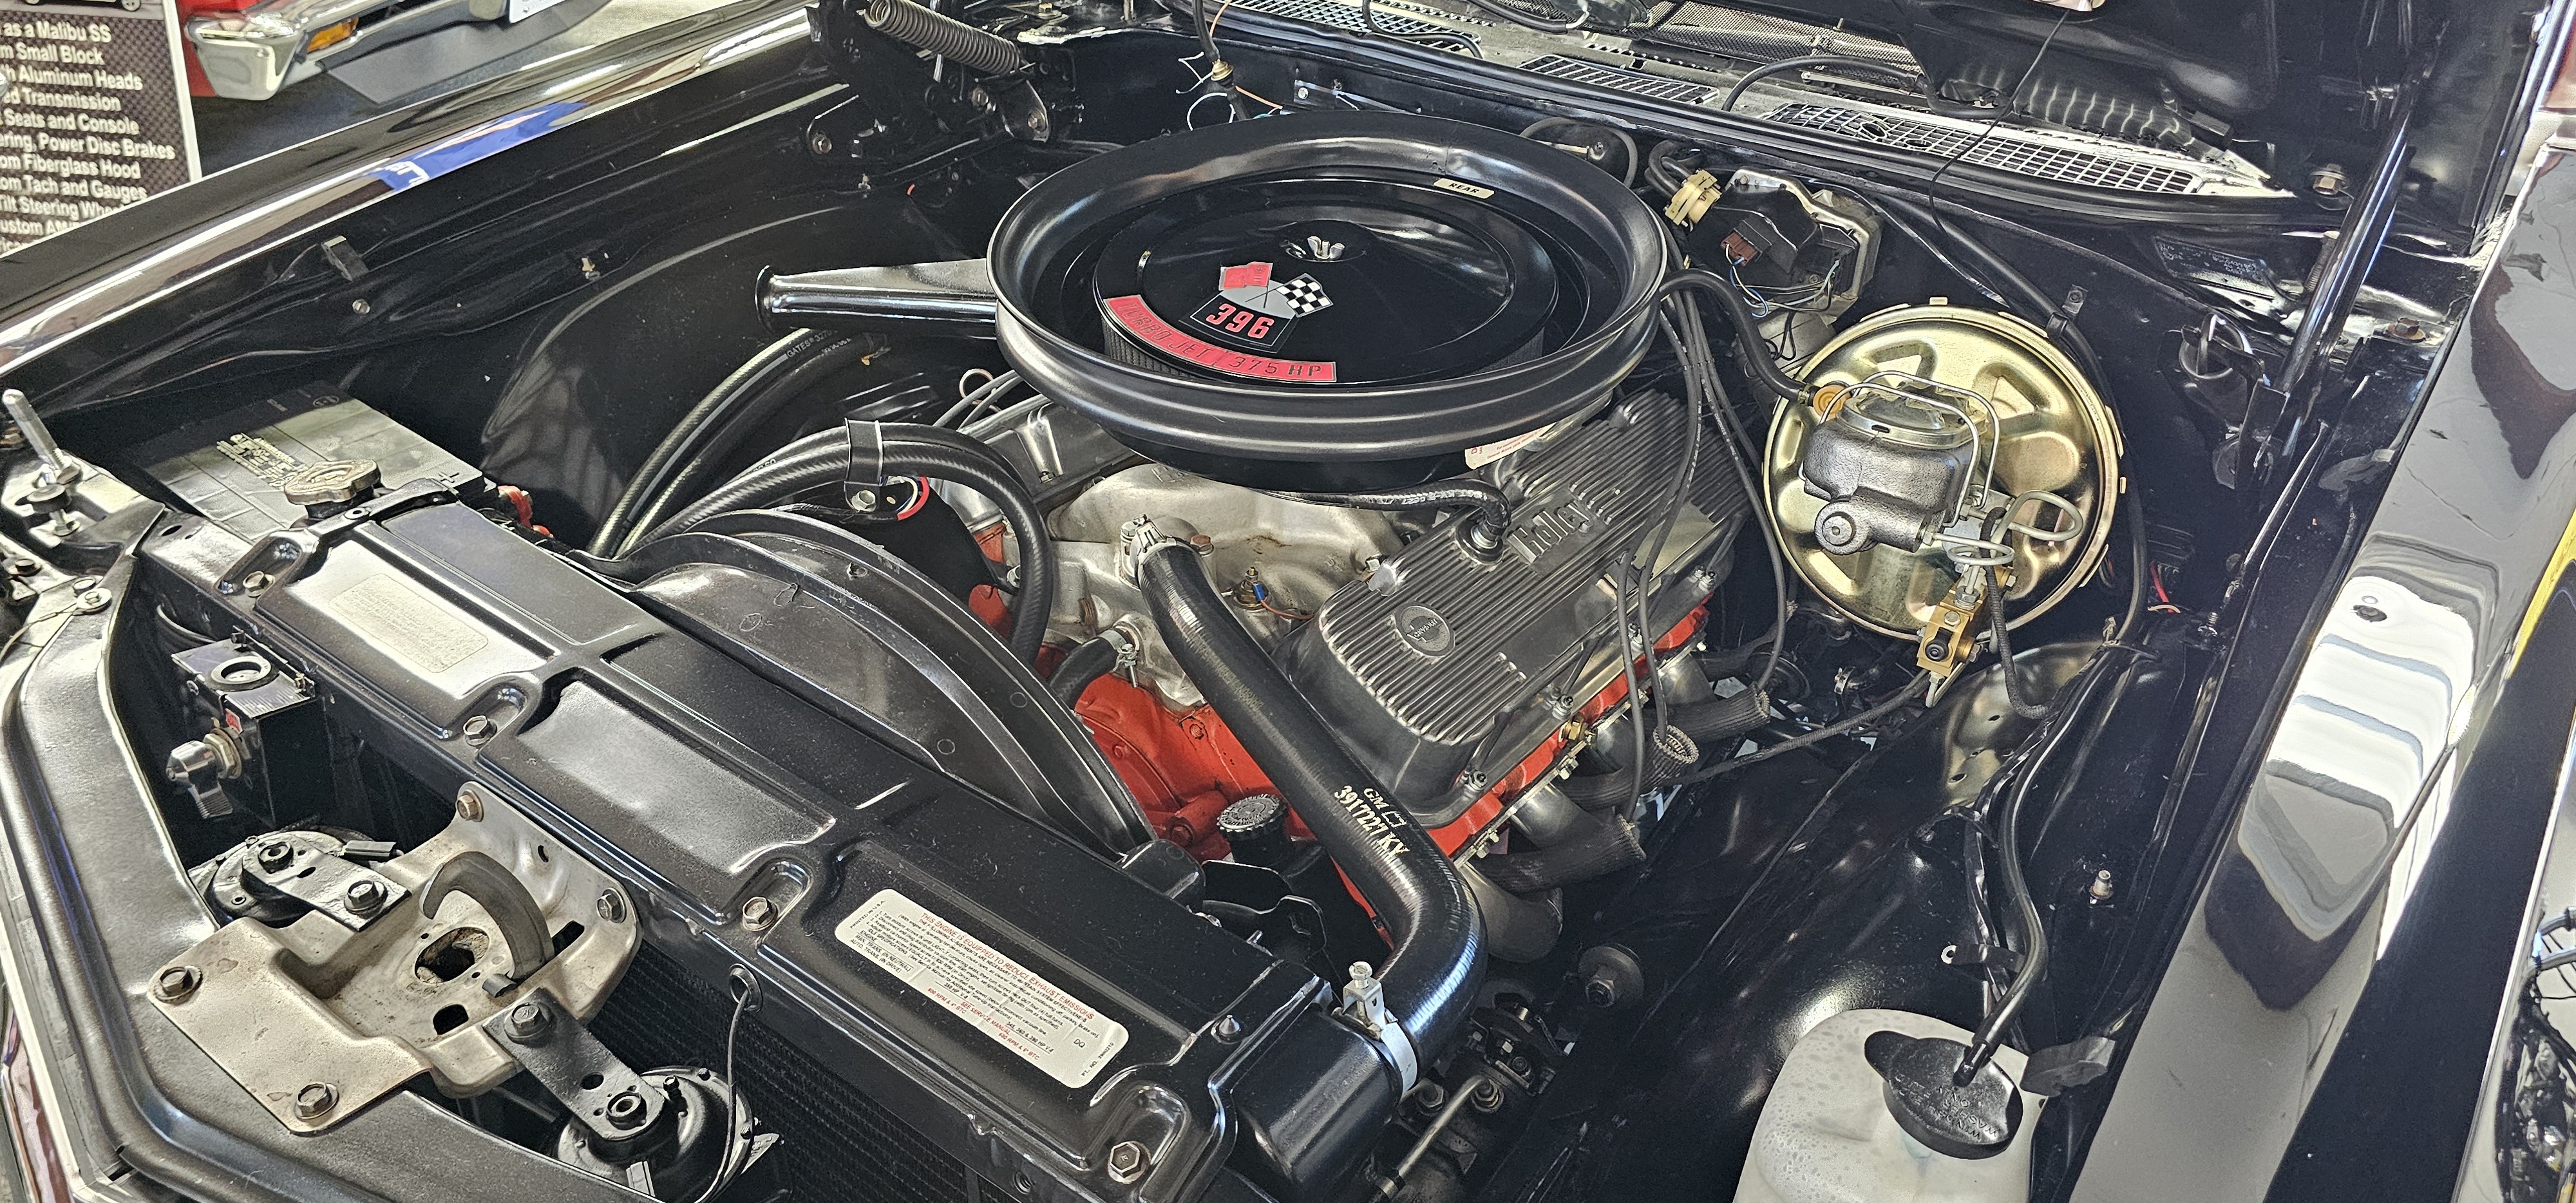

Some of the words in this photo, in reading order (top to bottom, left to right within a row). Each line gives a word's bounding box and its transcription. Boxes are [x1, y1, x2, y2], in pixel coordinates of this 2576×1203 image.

[3, 23, 22, 37] as
[24, 23, 35, 37] a
[36, 21, 87, 41] Malibu
[88, 24, 111, 43] SS
[15, 41, 59, 62] Small
[60, 44, 104, 64] Block
[19, 64, 93, 87] Aluminum
[93, 70, 144, 91] Heads
[22, 86, 122, 111] Transmission
[4, 108, 46, 128] Seats
[47, 112, 77, 130] and
[77, 113, 140, 135] Console
[37, 132, 84, 153] Power
[86, 135, 121, 155] Disc
[121, 138, 176, 160] Brakes
[22, 153, 99, 177] Fiberglass
[99, 158, 141, 178] Hood
[23, 175, 59, 194] Tach
[60, 179, 90, 196] and
[90, 180, 148, 204] Gauges
[1448, 183, 1479, 193] REAR
[17, 196, 79, 221] Steering
[1206, 303, 1274, 339] 396
[1117, 302, 1214, 359] TURBO-JET
[1229, 357, 1278, 374] 375
[1288, 365, 1321, 377] HP
[1507, 502, 1594, 563] Holley
[1363, 788, 1390, 811] GM
[1334, 785, 1389, 836] 3917227
[1377, 831, 1410, 857] KY
[849, 913, 868, 929] PRINTED
[860, 930, 877, 942] ENGINE
[849, 939, 864, 948] AUTO.
[863, 947, 880, 958] TRANS.
[885, 961, 902, 972] DRIVE)
[866, 942, 882, 953] TRANS.
[888, 956, 911, 971] NEUTRAL)
[921, 913, 935, 923] THIS
[934, 921, 958, 936] ENGINE
[963, 938, 994, 959] EQUIPPED
[1003, 962, 1029, 980] REDUCE
[1028, 978, 1060, 998] EXHAUST
[1058, 996, 1094, 1019] EMISSIONS
[985, 960, 1010, 976] NECESSARY
[1036, 990, 1054, 1001] SYSTEM
[955, 1005, 967, 1014] BTC
[1030, 995, 1056, 1012] conditioning
[970, 1007, 991, 1021] SERVICE
[990, 1019, 1012, 1034] MANUAL
[1007, 1038, 1019, 1047] RPM
[1027, 1051, 1039, 1059] BTC
[1074, 1038, 1086, 1047] DQ
[1941, 1099, 1997, 1137] WASHER
